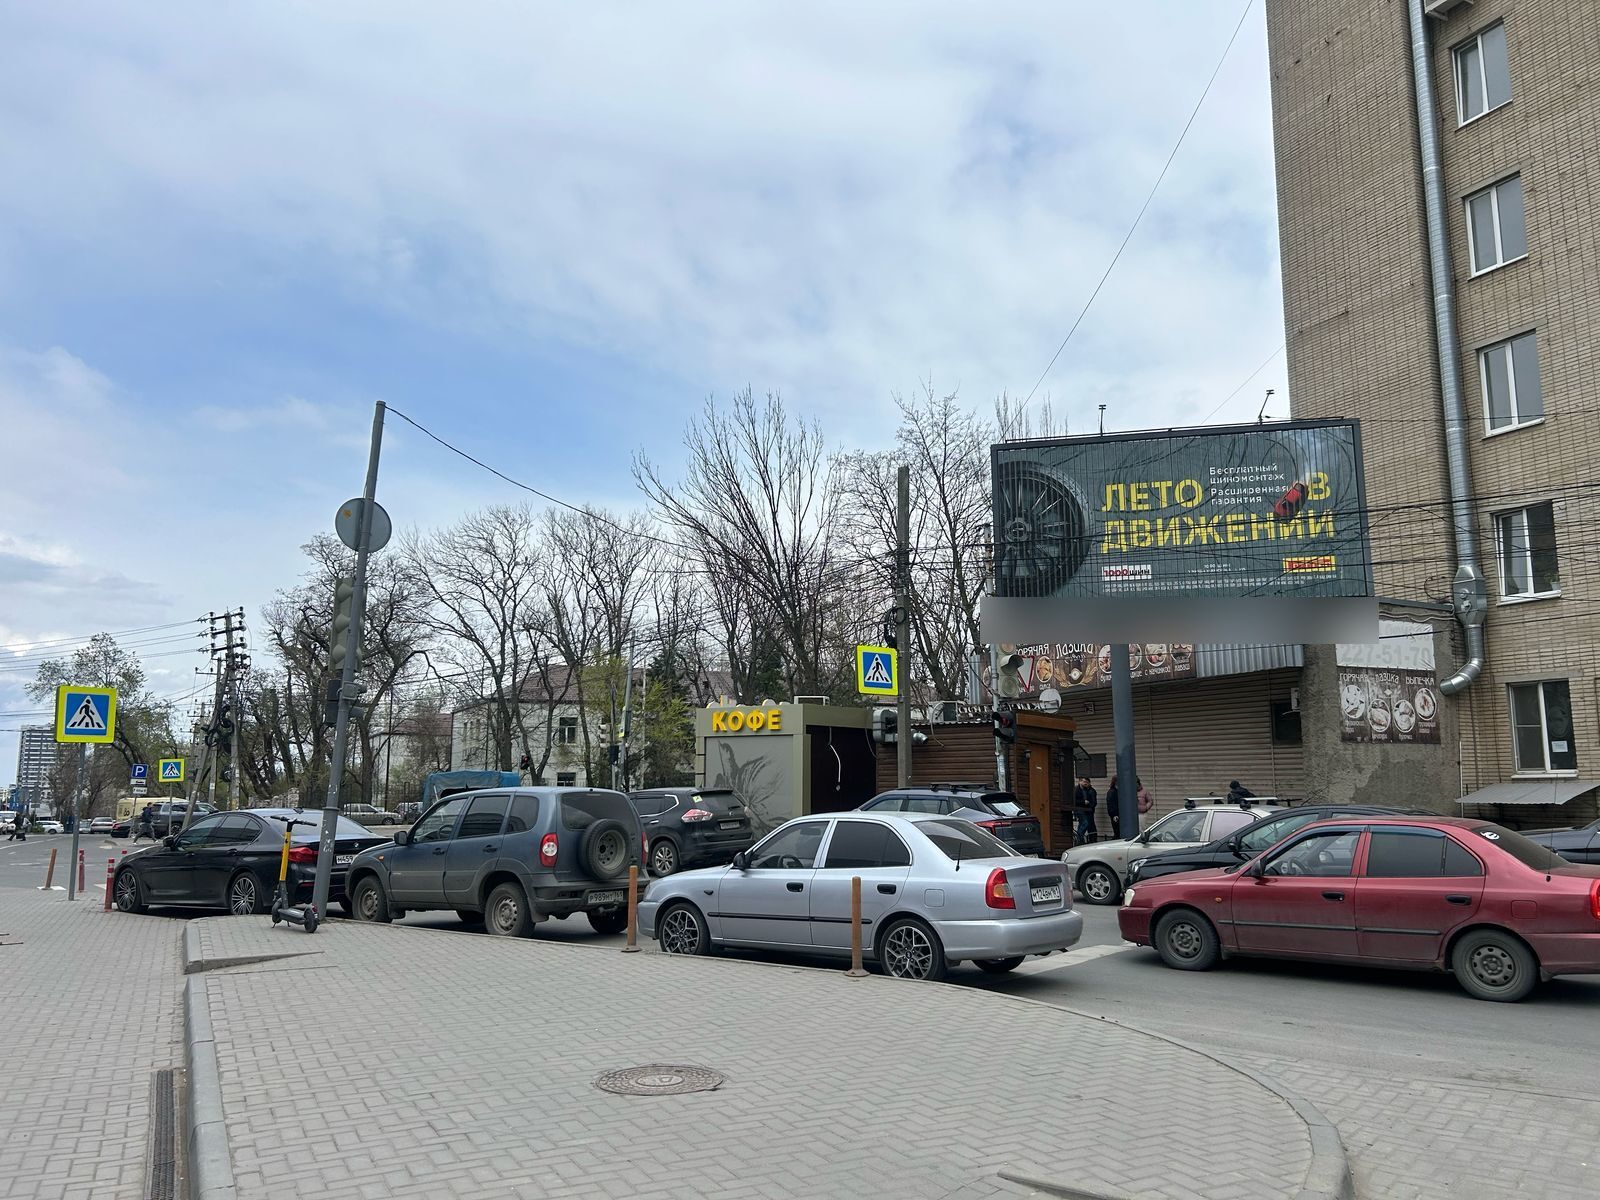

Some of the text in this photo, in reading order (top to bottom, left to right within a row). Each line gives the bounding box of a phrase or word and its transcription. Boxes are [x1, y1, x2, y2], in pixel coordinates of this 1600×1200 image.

[1209, 463, 1278, 475] Бесплатный
[1210, 473, 1285, 484] шиномонтаж
[1101, 471, 1331, 512] ЛЕТО В
[1211, 496, 1262, 505] гарантия
[1101, 508, 1335, 554] ДВИЖЕНИИ
[1016, 643, 1051, 656] ОРЯЧАЯ
[712, 709, 783, 732] КОФЕ
